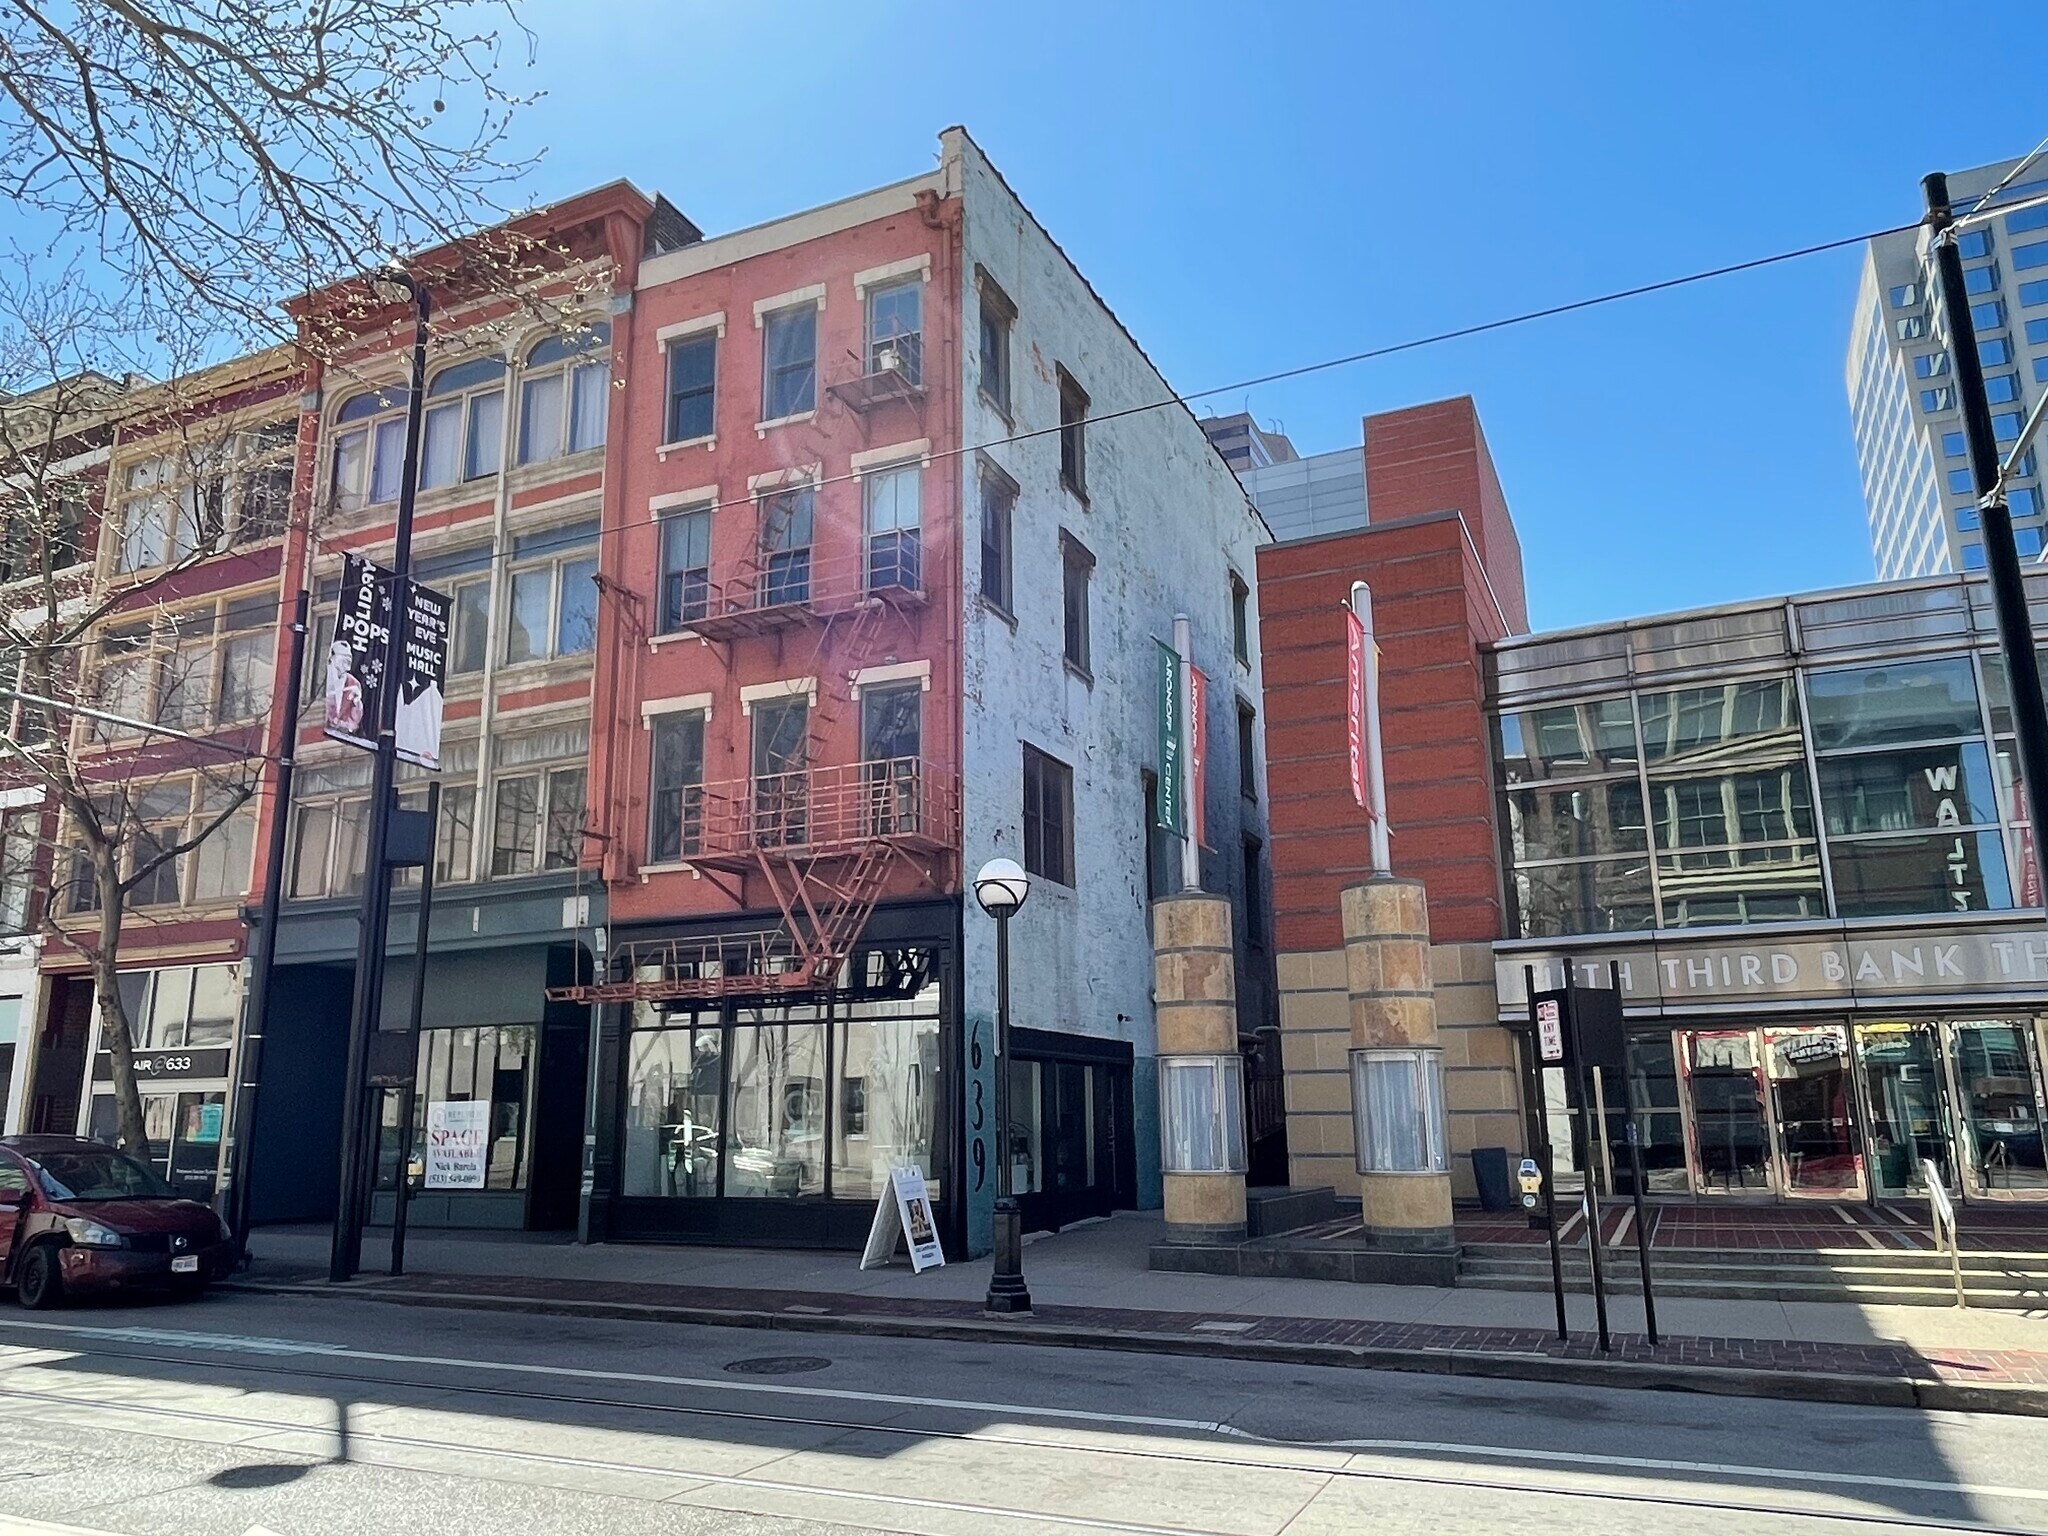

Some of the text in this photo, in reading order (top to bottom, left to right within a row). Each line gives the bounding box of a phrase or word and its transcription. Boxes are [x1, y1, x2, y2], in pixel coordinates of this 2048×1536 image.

[352, 559, 376, 653] HOLIDAY
[415, 595, 441, 616] NEW
[342, 613, 390, 645] POPS
[407, 606, 446, 633] YEAR'S
[415, 626, 437, 645] EVE
[406, 641, 442, 665] MUSIC
[408, 656, 436, 677] HALL
[1165, 656, 1174, 732] ARONOFF
[1661, 953, 1799, 989] THIRD
[1821, 944, 1964, 982] BANK
[971, 1019, 986, 1192] 639
[431, 1130, 483, 1147] SPACE
